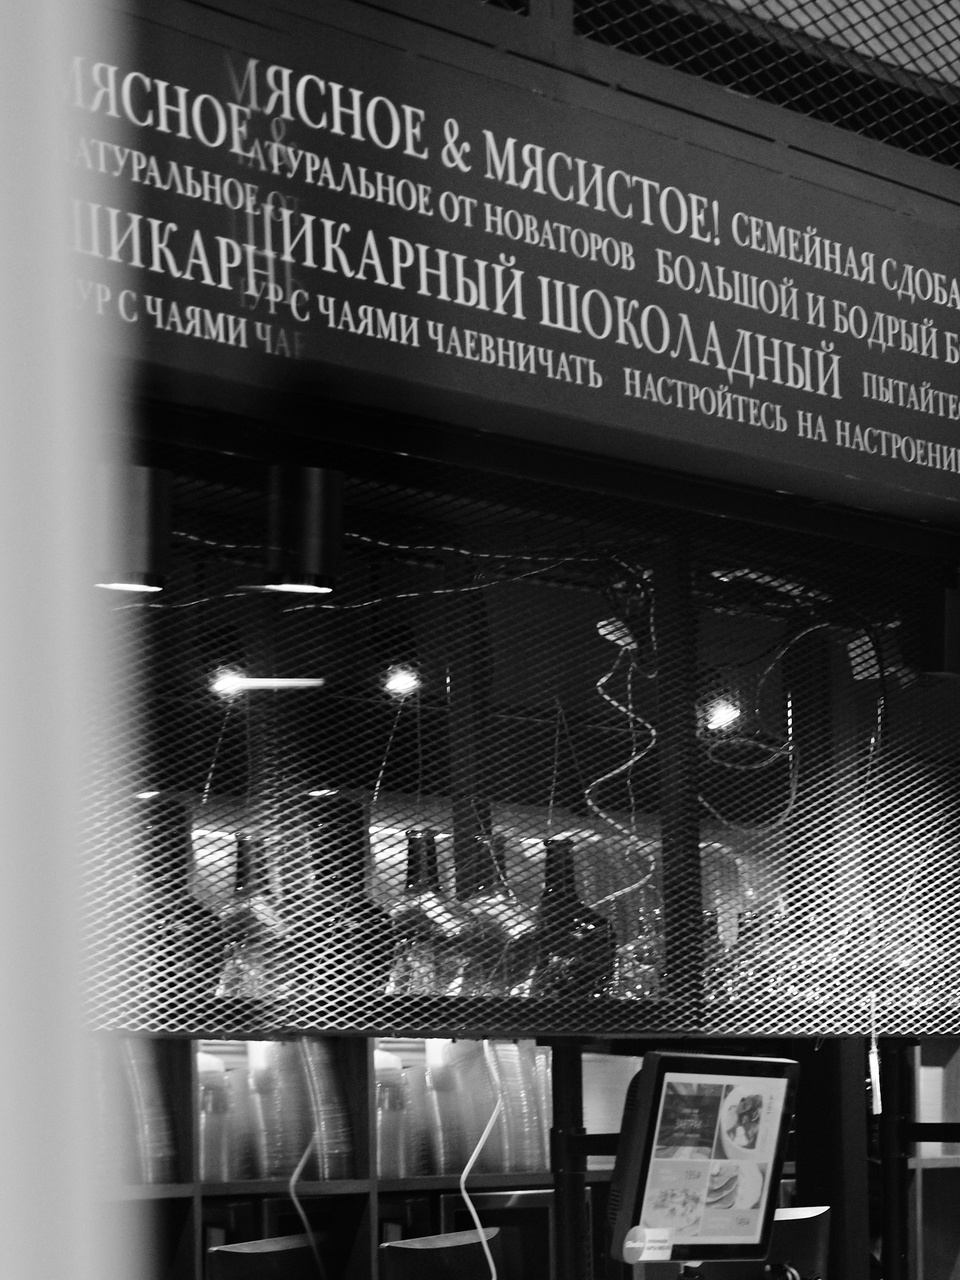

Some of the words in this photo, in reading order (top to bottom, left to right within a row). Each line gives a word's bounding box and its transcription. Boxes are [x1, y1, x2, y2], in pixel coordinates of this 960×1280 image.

[76, 137, 261, 215] АТУРАЛЬНОЕ
[441, 118, 471, 173] &
[483, 129, 720, 247] МЯСИСТОЕ!
[731, 212, 875, 285] СЕМЕЙНАЯ
[242, 137, 433, 216] АТУРАЛЬНОЕ
[439, 190, 477, 227] ОТ
[484, 203, 635, 271] НОВАТОРОВ
[656, 247, 800, 321] БОЛЬШОЙ
[806, 292, 826, 329] И
[833, 299, 939, 360] БОДРЫЙ
[143, 294, 248, 349] ЧАЯМИ
[290, 289, 311, 323] С
[317, 292, 421, 348] ЧАЯМИ
[427, 320, 603, 389] ЧАЕВНИЧАТЬ
[623, 366, 788, 433] НАСТРОЙТЕСЬ
[797, 410, 829, 443] НА
[538, 275, 843, 399] ШОКОЛАДНЫЙ
